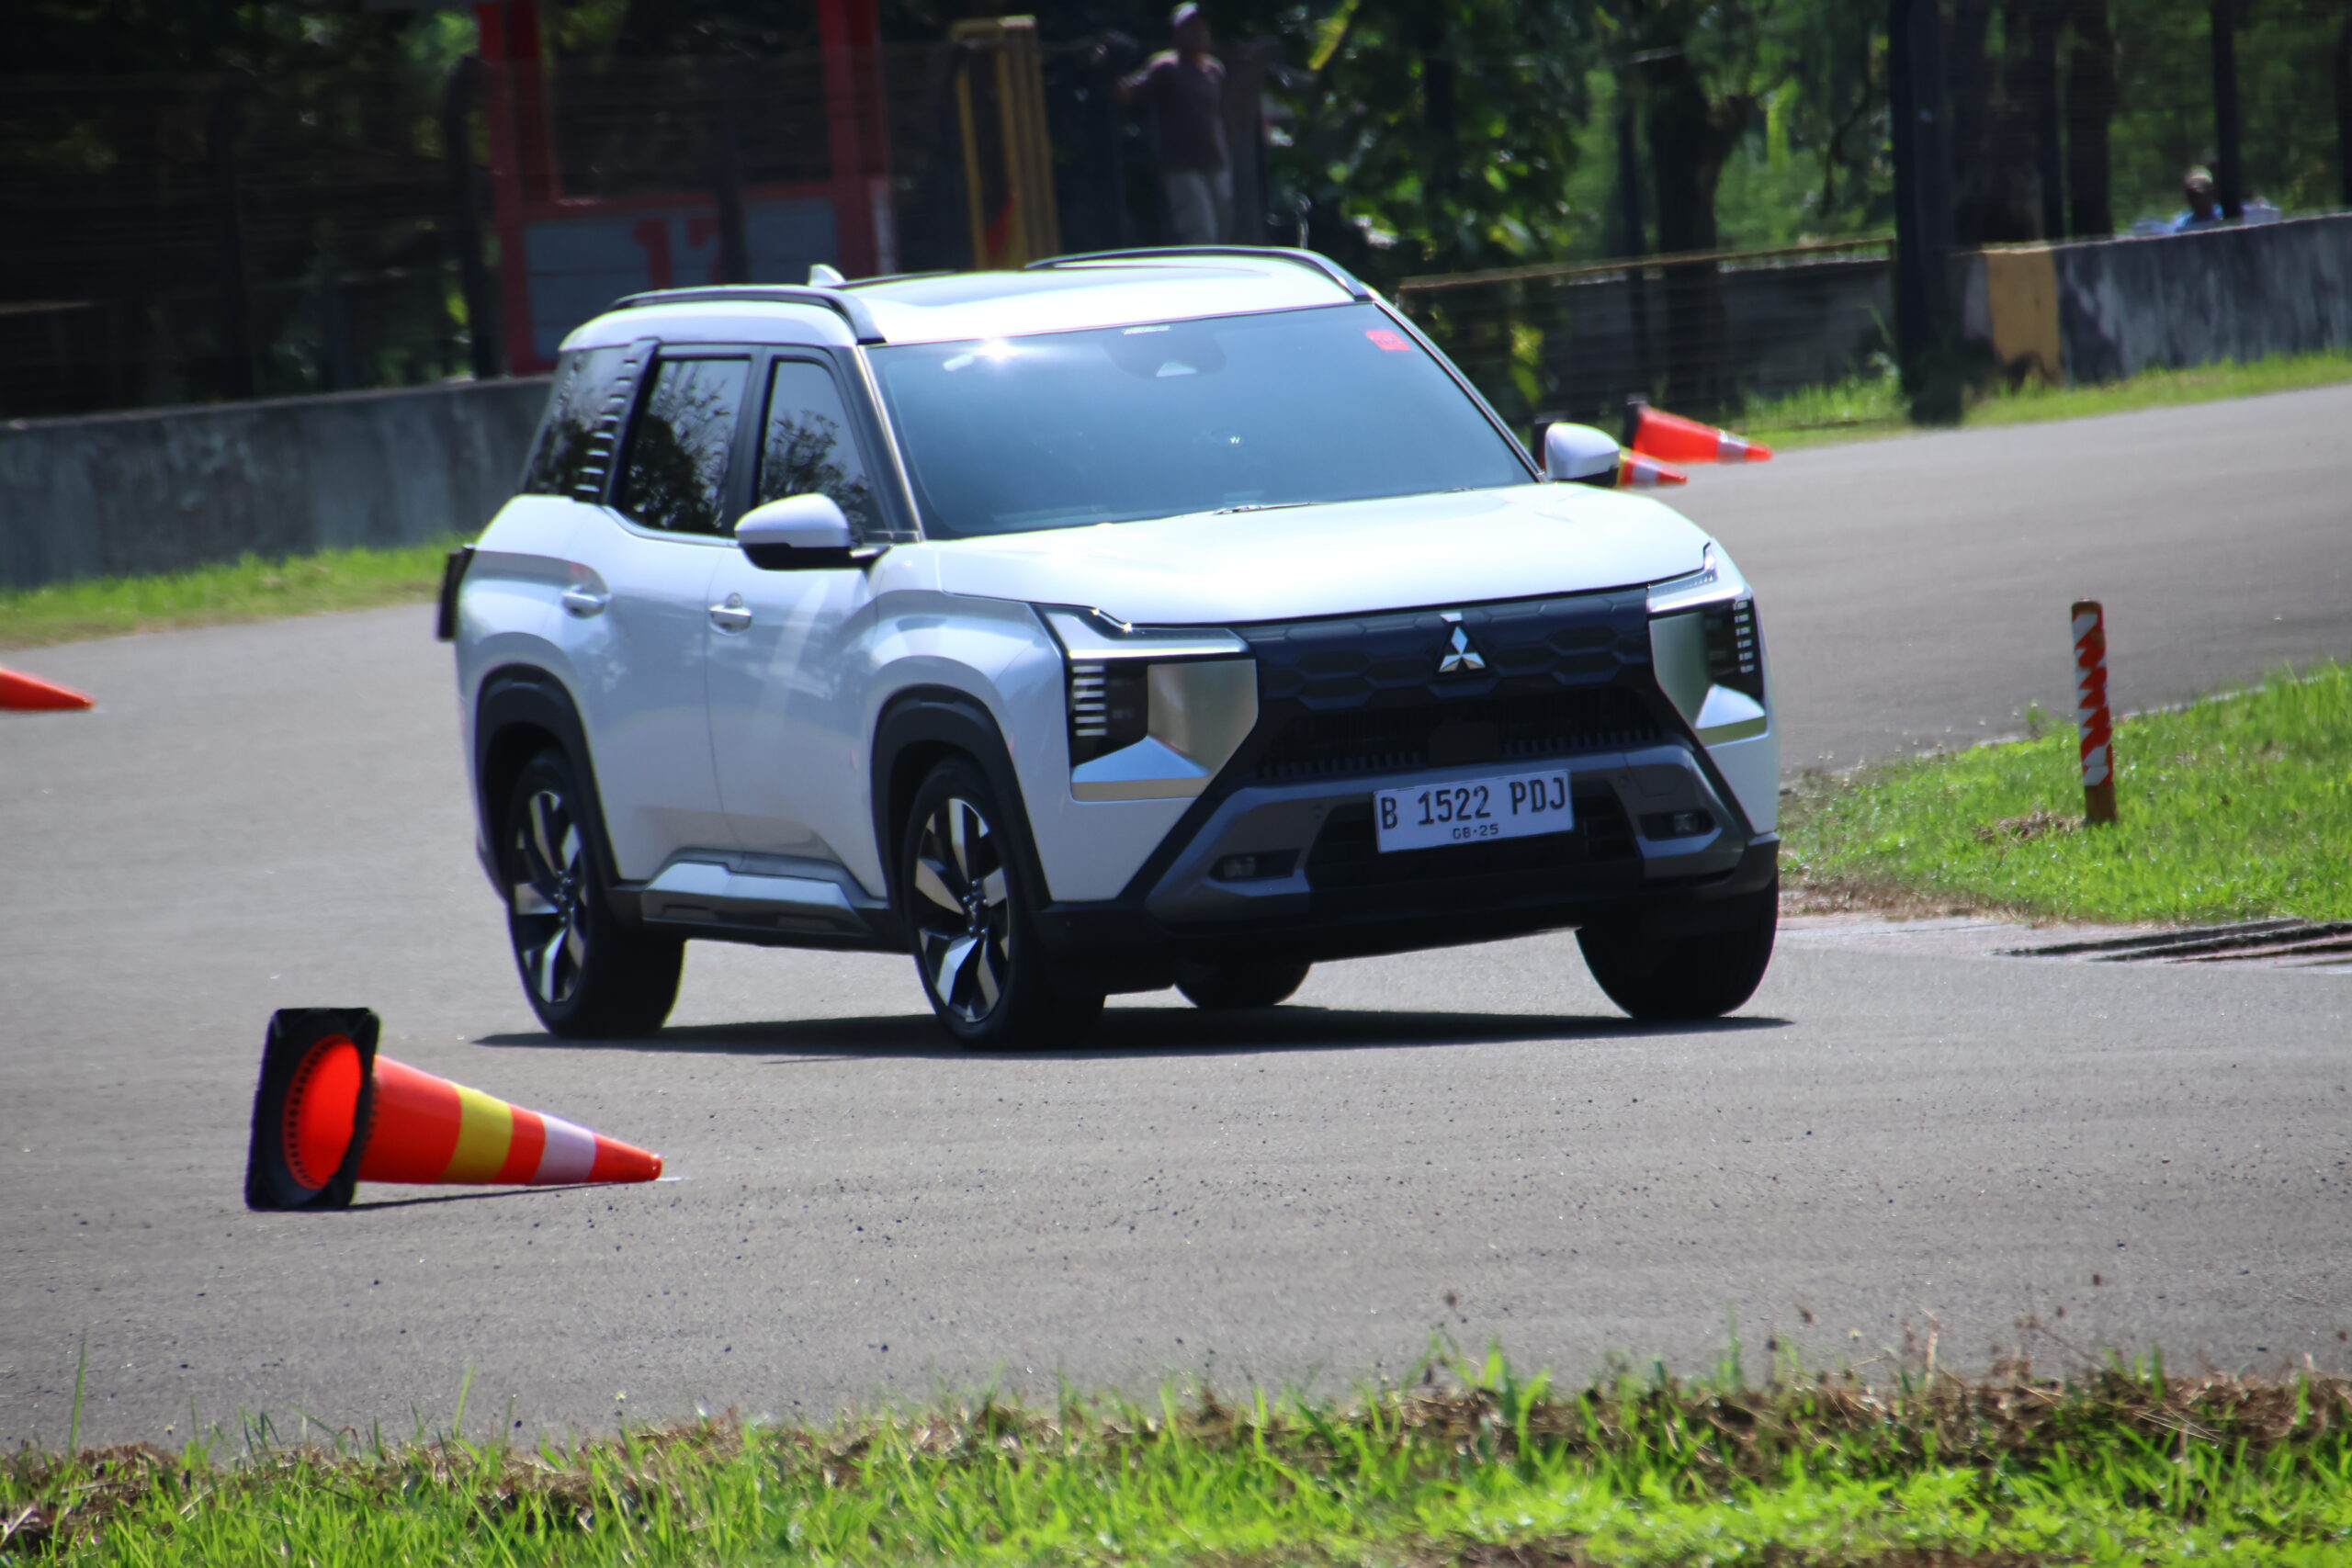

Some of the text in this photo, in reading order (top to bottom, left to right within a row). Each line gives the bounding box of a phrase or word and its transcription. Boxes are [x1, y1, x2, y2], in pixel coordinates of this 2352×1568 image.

[1382, 776, 1566, 829] B 1522 PDJ
